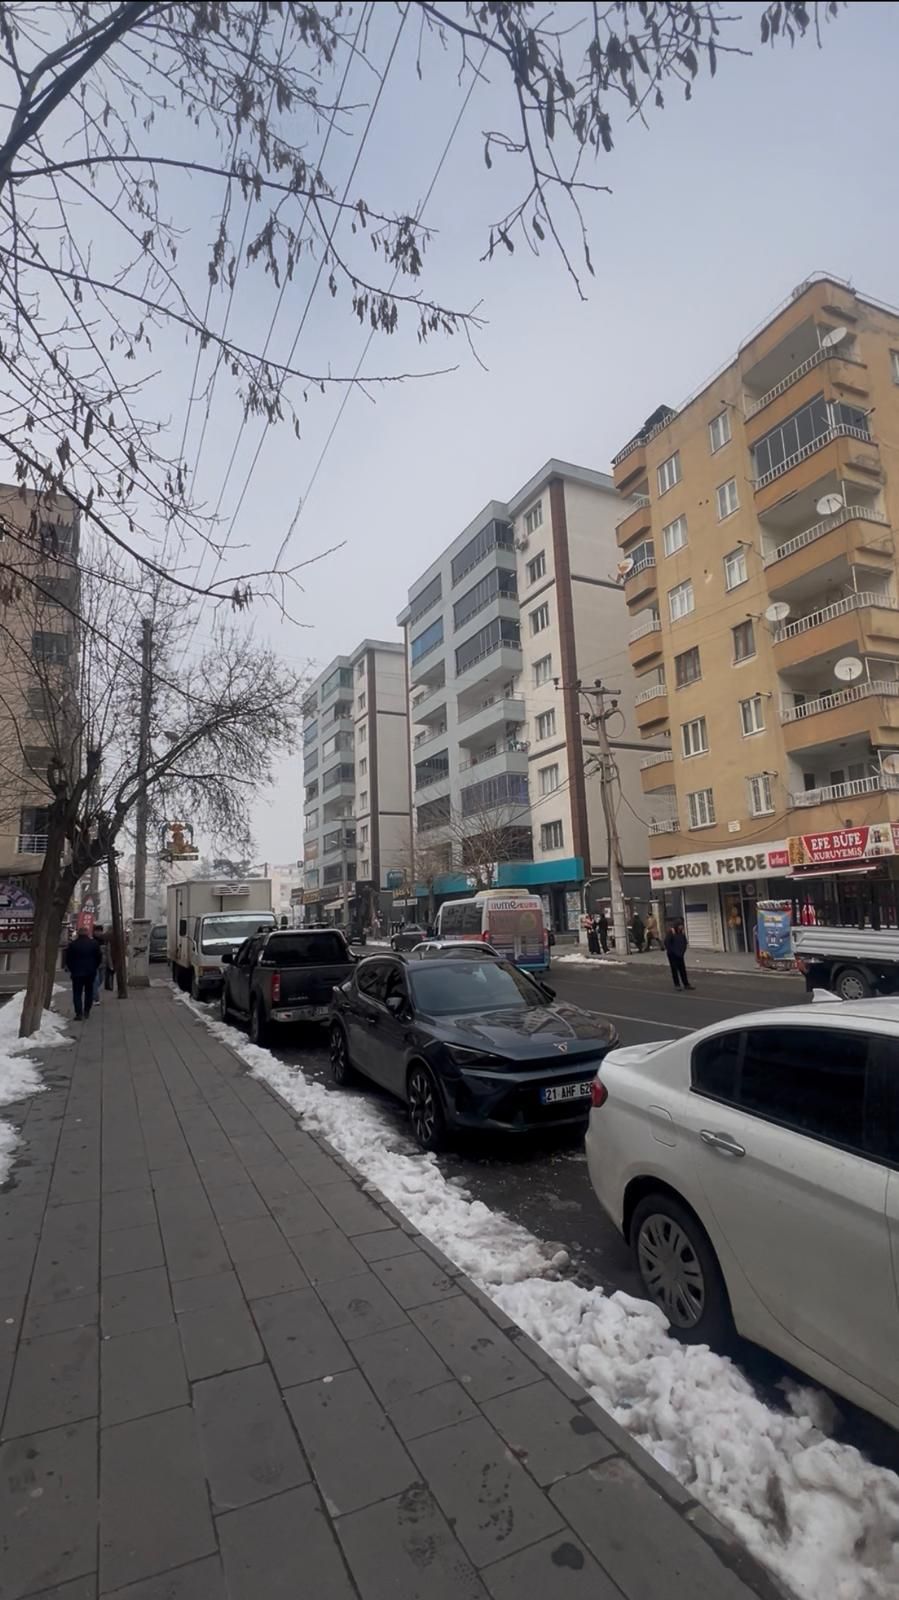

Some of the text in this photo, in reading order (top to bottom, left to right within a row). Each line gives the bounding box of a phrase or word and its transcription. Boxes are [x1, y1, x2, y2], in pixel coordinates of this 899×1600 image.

[811, 832, 862, 850] EFE BÜFE
[667, 861, 711, 880] DEKOR
[716, 854, 767, 874] PERDE
[546, 1088, 557, 1100] 21
[561, 1085, 577, 1098] AHF
